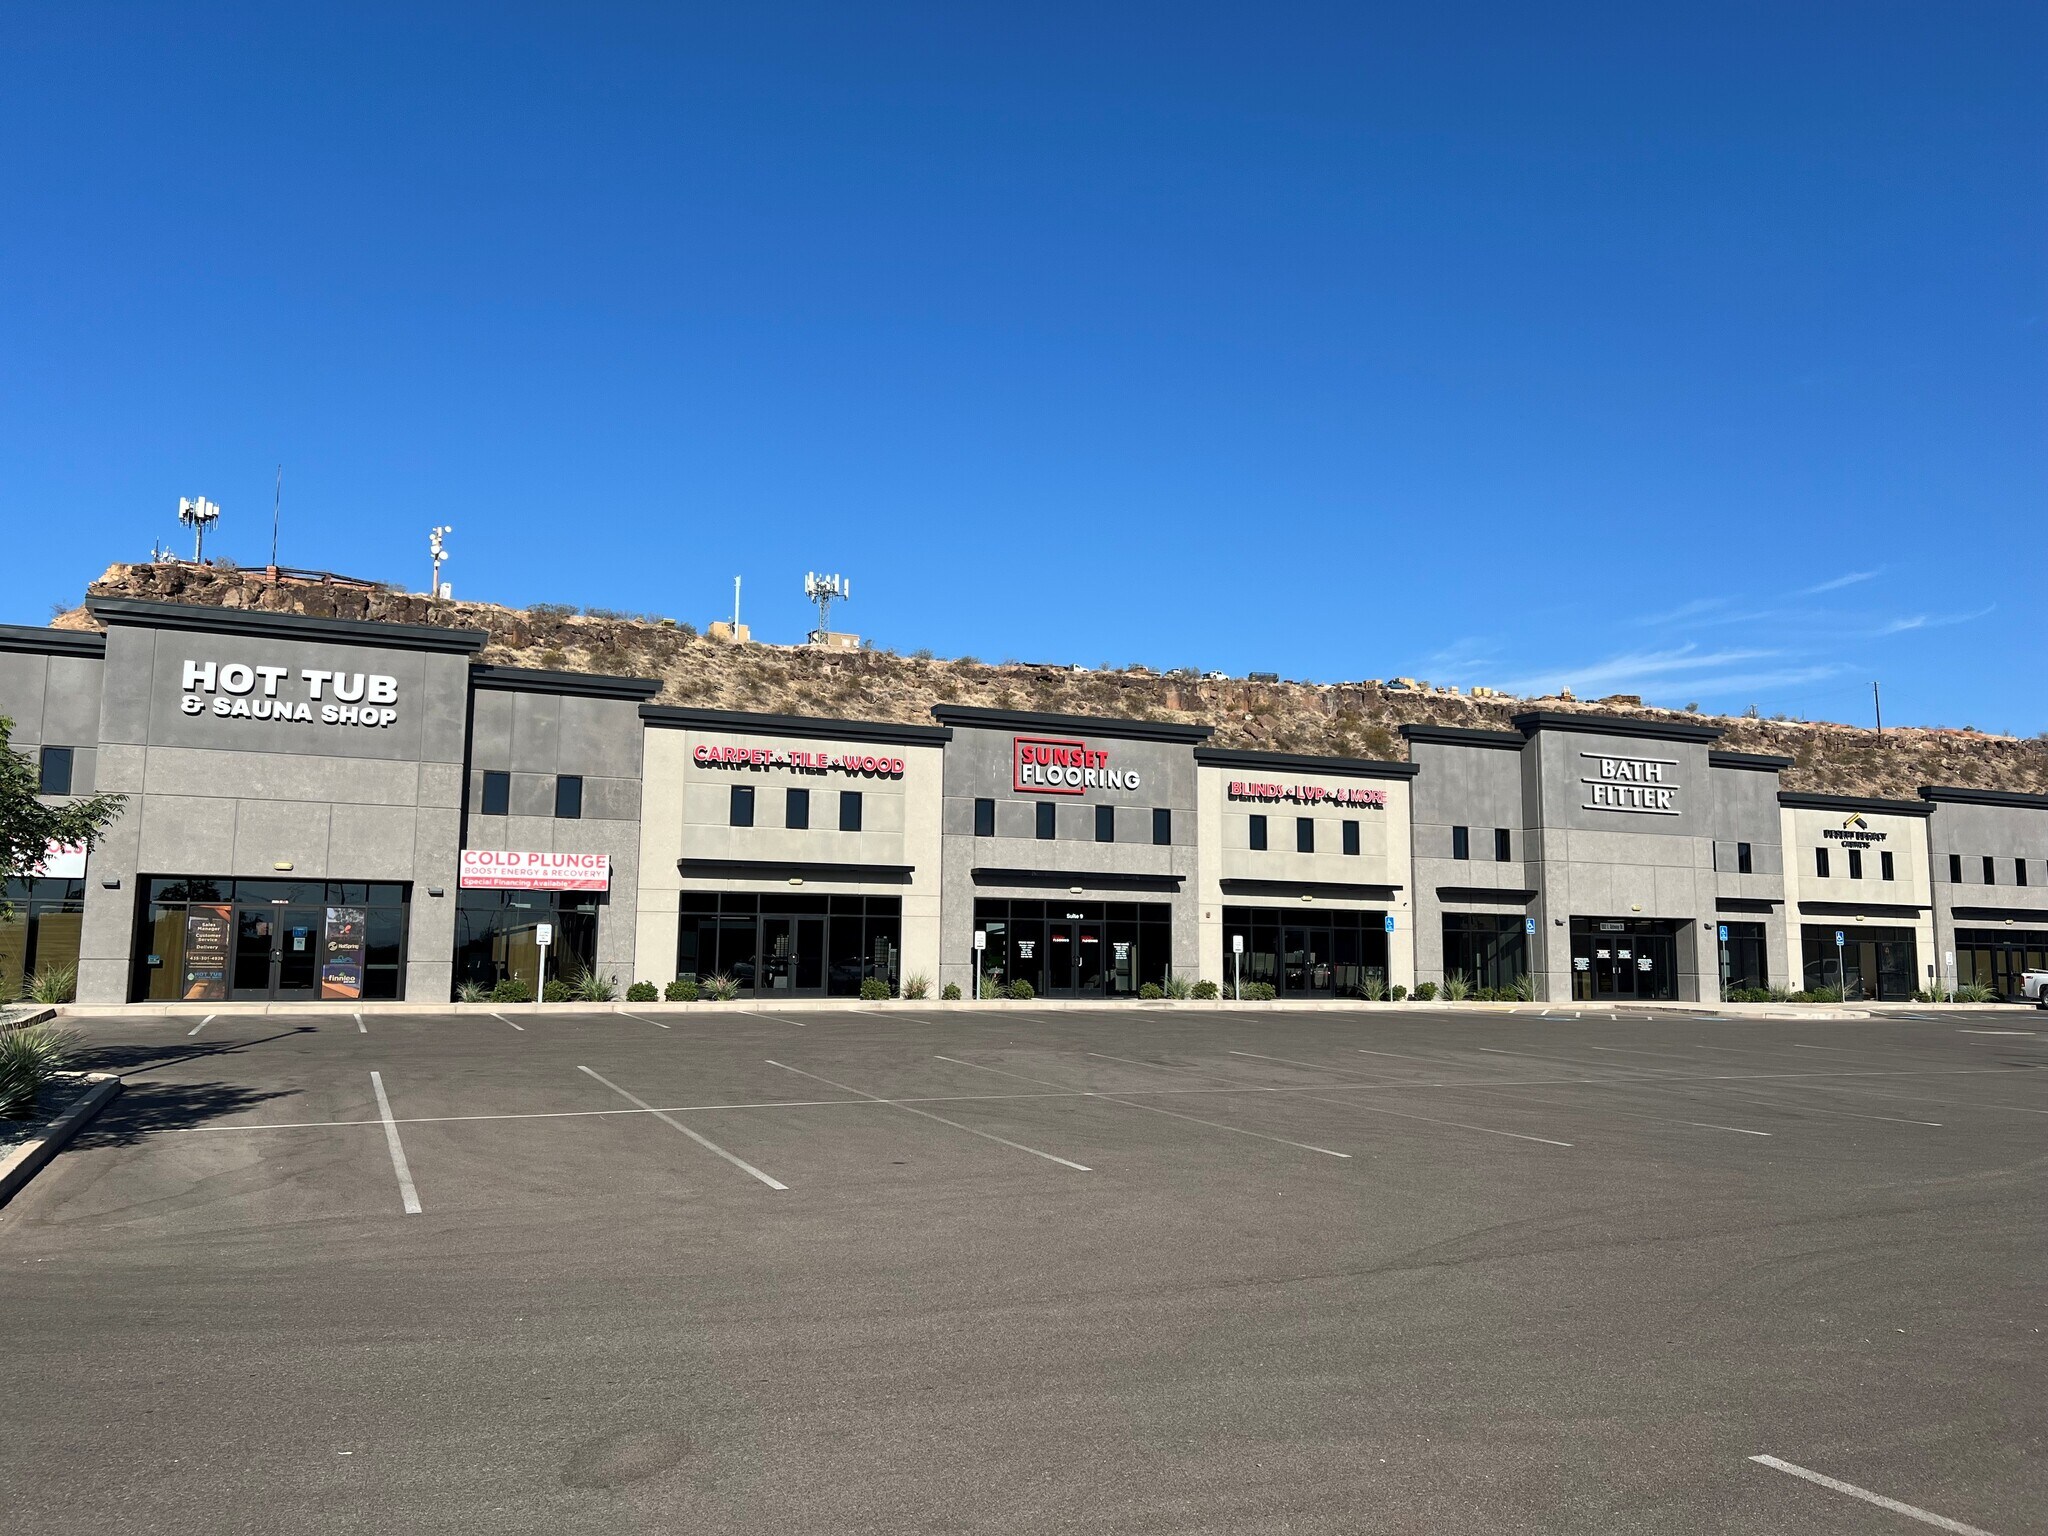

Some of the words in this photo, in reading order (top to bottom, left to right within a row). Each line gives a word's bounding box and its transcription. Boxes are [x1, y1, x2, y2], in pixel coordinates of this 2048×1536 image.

[182, 660, 288, 697] HOT
[302, 669, 398, 706] TUB
[181, 695, 205, 715] &
[212, 697, 313, 723] SAUNA
[321, 705, 397, 728] SHOP
[694, 745, 773, 766] CARPET
[789, 751, 828, 769] TILE
[843, 755, 905, 774] WOOD
[1022, 745, 1108, 769] SUNSET
[1022, 764, 1140, 790] FLOORING
[1600, 759, 1662, 782] BATH
[1230, 781, 1284, 797] BLINDS
[1296, 785, 1325, 800] LVP
[1337, 788, 1347, 802] &
[1350, 789, 1387, 804] MORE
[1592, 784, 1672, 809] FITTER
[464, 851, 521, 866] COLD
[528, 853, 607, 869] PLUNGE
[463, 878, 492, 886] Special
[494, 879, 531, 887] Financing
[464, 867, 498, 875] BOOST
[501, 868, 540, 876] ENERGY
[551, 870, 606, 878] RECOVERY!
